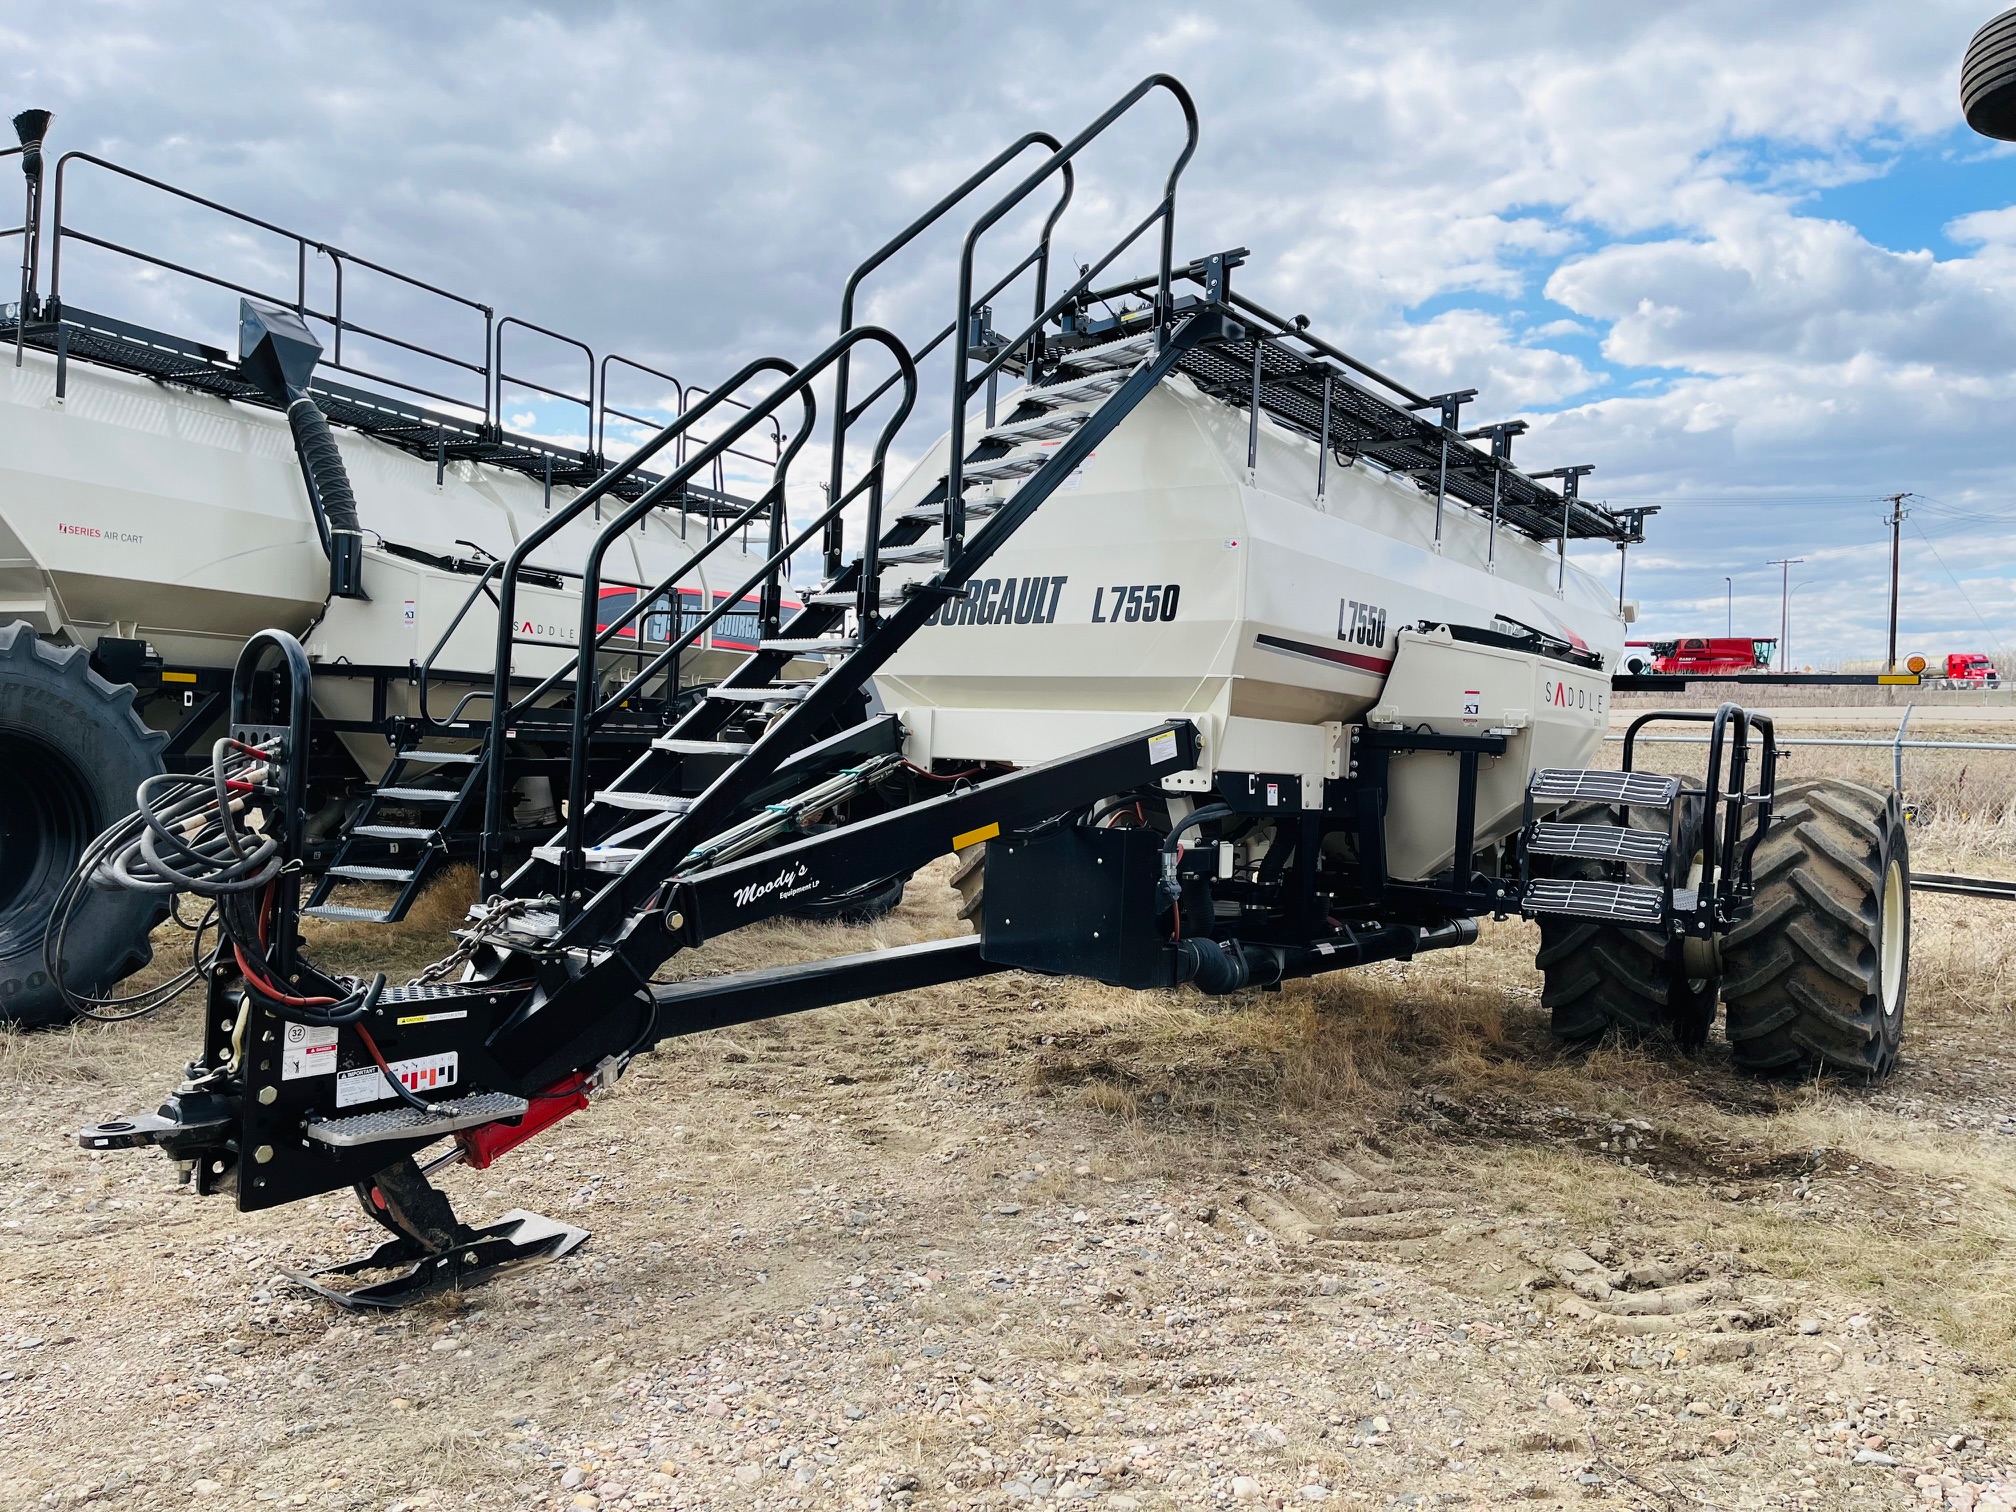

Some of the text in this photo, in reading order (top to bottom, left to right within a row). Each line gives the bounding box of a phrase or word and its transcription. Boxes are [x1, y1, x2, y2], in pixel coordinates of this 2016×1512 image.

[68, 525, 101, 538] SERIES
[104, 531, 119, 541] AIR
[121, 533, 143, 544] CART
[513, 621, 574, 639] SADDLE
[1337, 598, 1387, 649] L7550
[1545, 681, 1603, 714] SADDLE
[733, 861, 808, 907] Moody's
[779, 880, 820, 900] Equipment LP
[292, 1028, 302, 1037] 32
[347, 1067, 376, 1078] IMPORTANT
